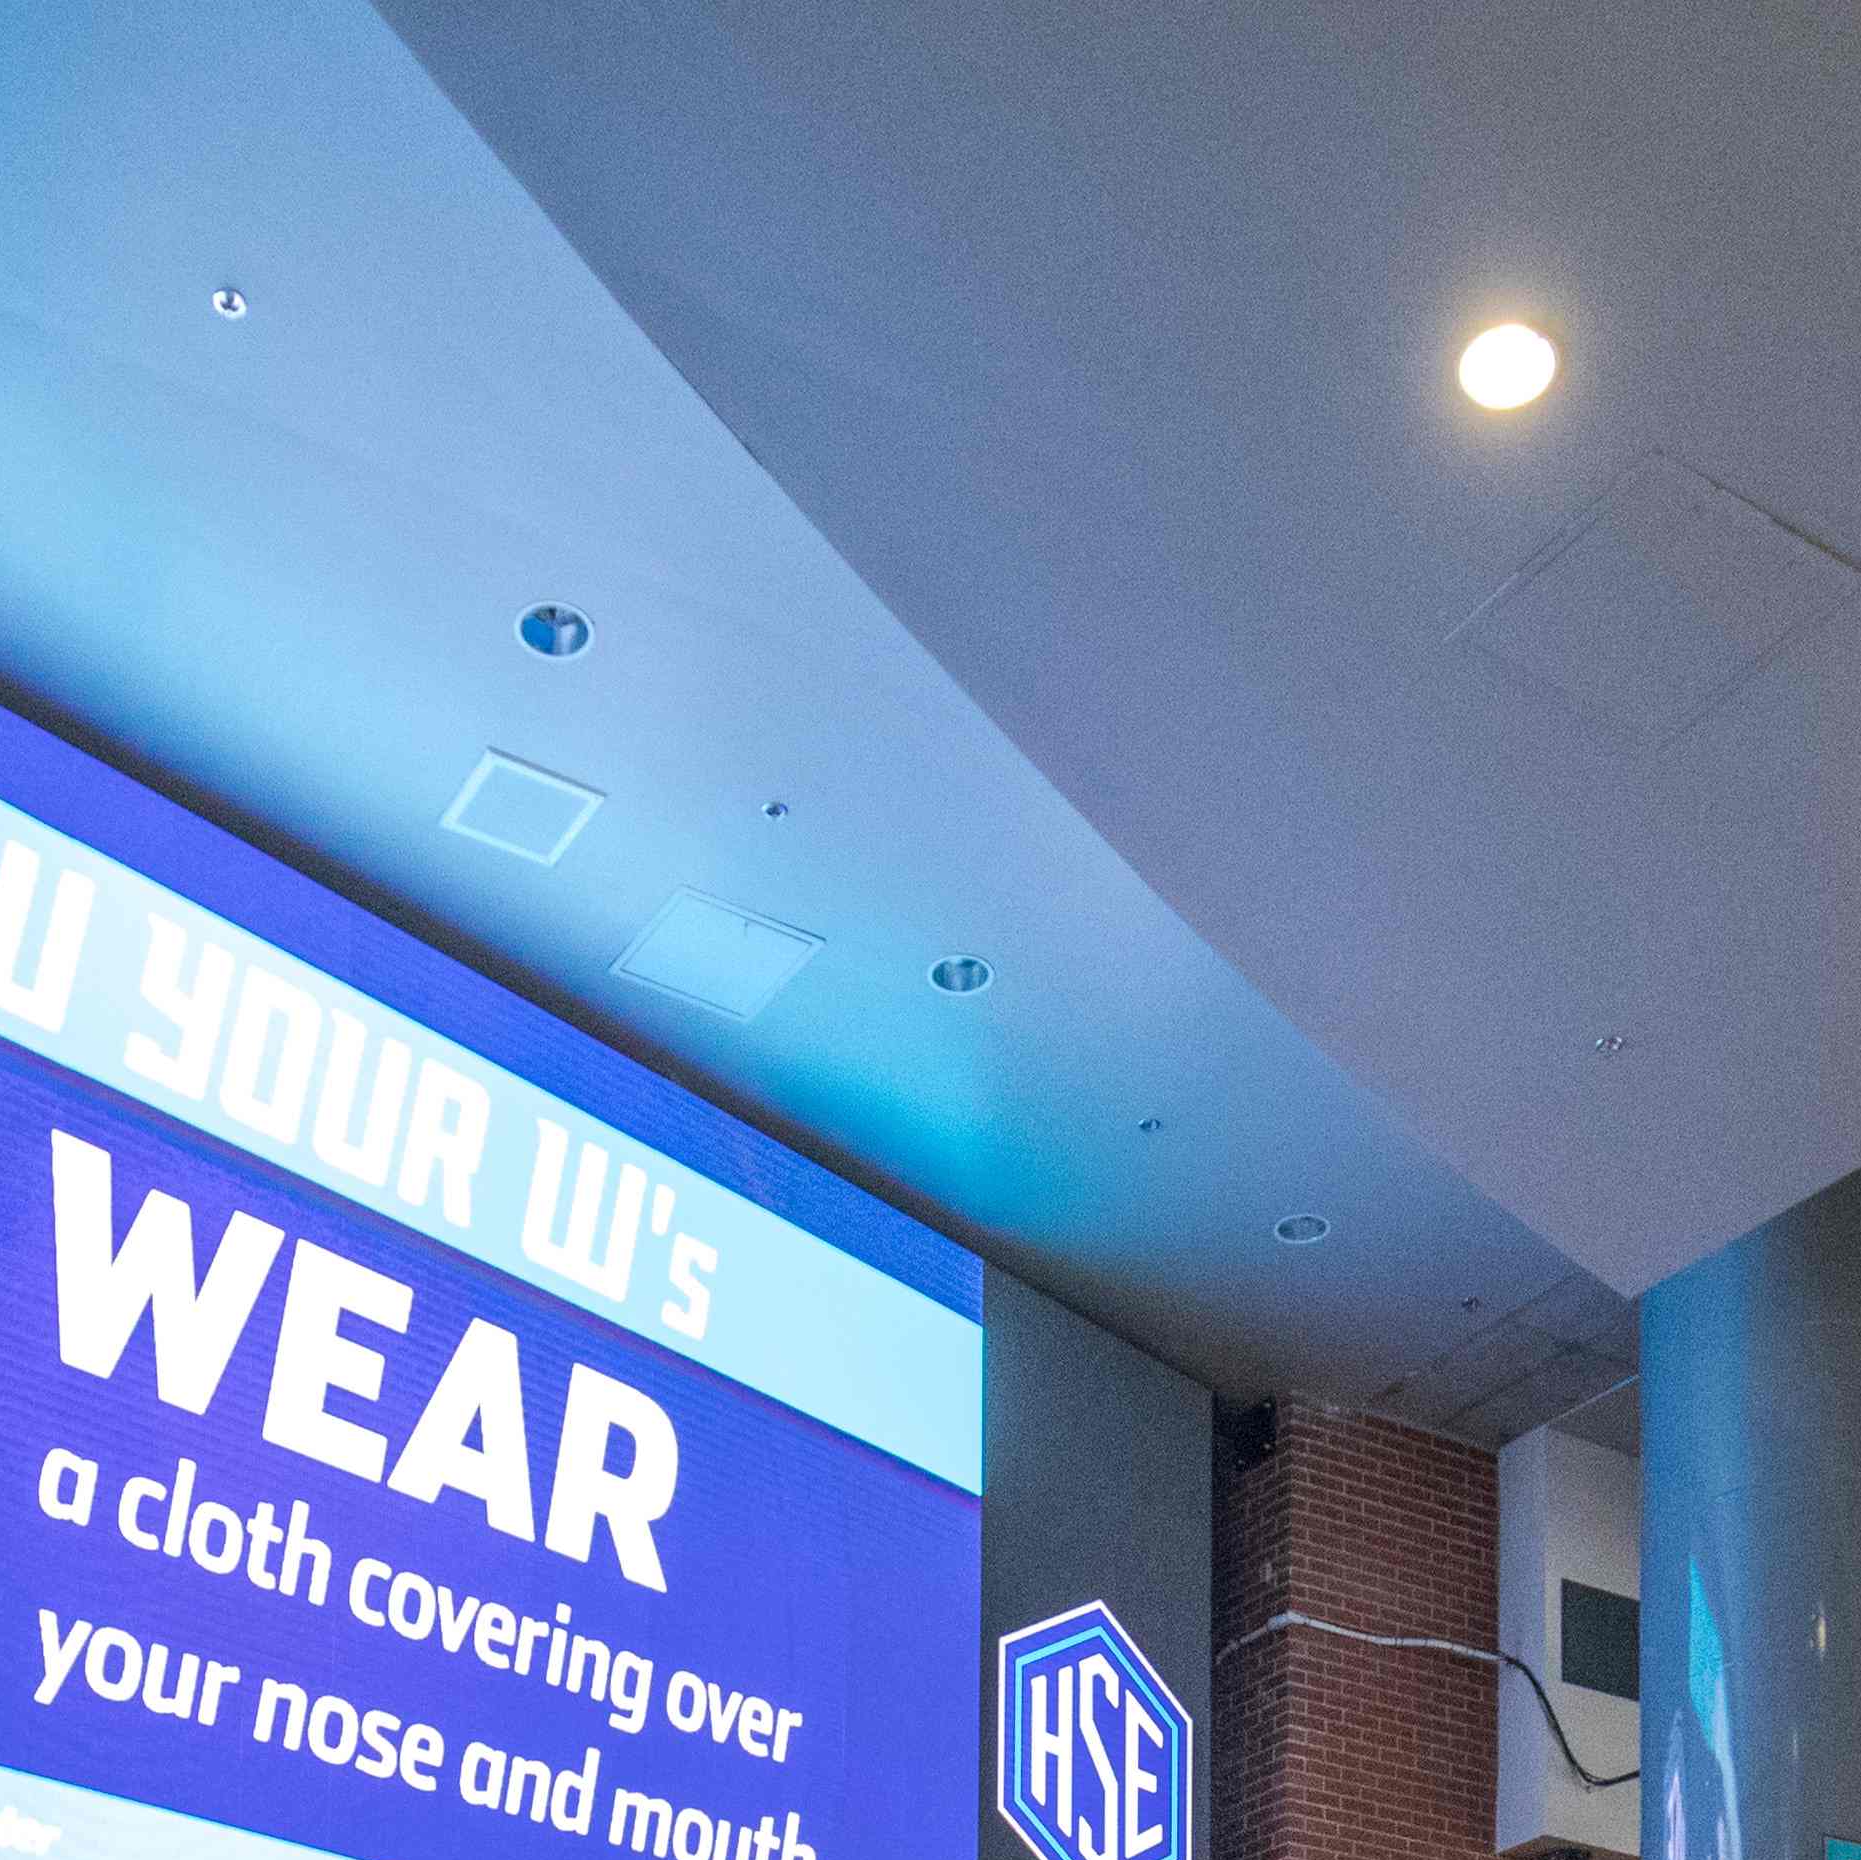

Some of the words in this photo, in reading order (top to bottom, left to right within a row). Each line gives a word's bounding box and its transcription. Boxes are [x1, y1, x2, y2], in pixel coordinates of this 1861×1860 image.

[123, 911, 491, 1228] YOUR
[519, 1116, 718, 1341] W's
[50, 1127, 677, 1593] WEAR
[34, 1609, 239, 1726] your
[253, 1678, 443, 1791] nose
[459, 1748, 601, 1836] and
[38, 1447, 98, 1527] a
[117, 1457, 331, 1605] cloth
[349, 1557, 652, 1735] covering
[666, 1670, 803, 1763] over
